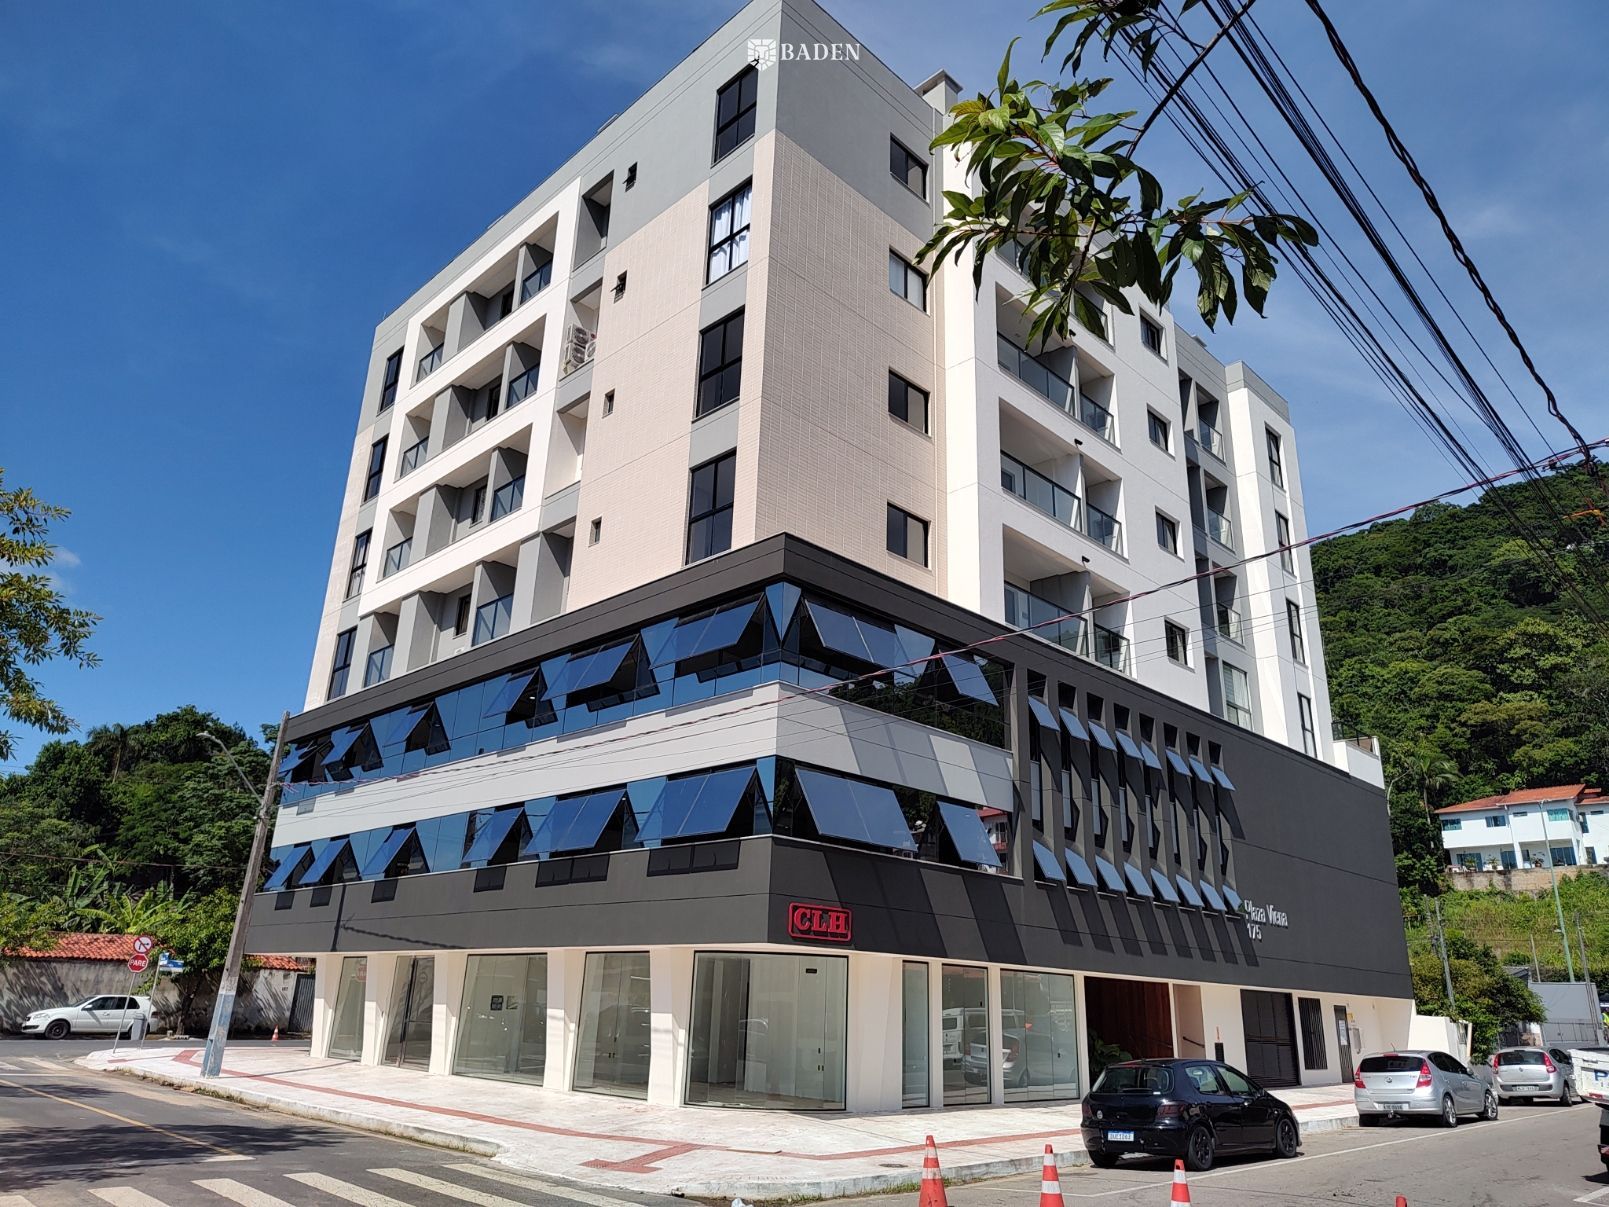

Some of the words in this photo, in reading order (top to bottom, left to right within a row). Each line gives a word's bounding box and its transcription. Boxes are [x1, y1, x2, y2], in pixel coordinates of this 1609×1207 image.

[793, 907, 848, 933] CLH
[1244, 900, 1266, 922] Plaza
[1266, 904, 1288, 926] Viena
[1247, 923, 1262, 939] 175
[129, 959, 147, 967] PARE
